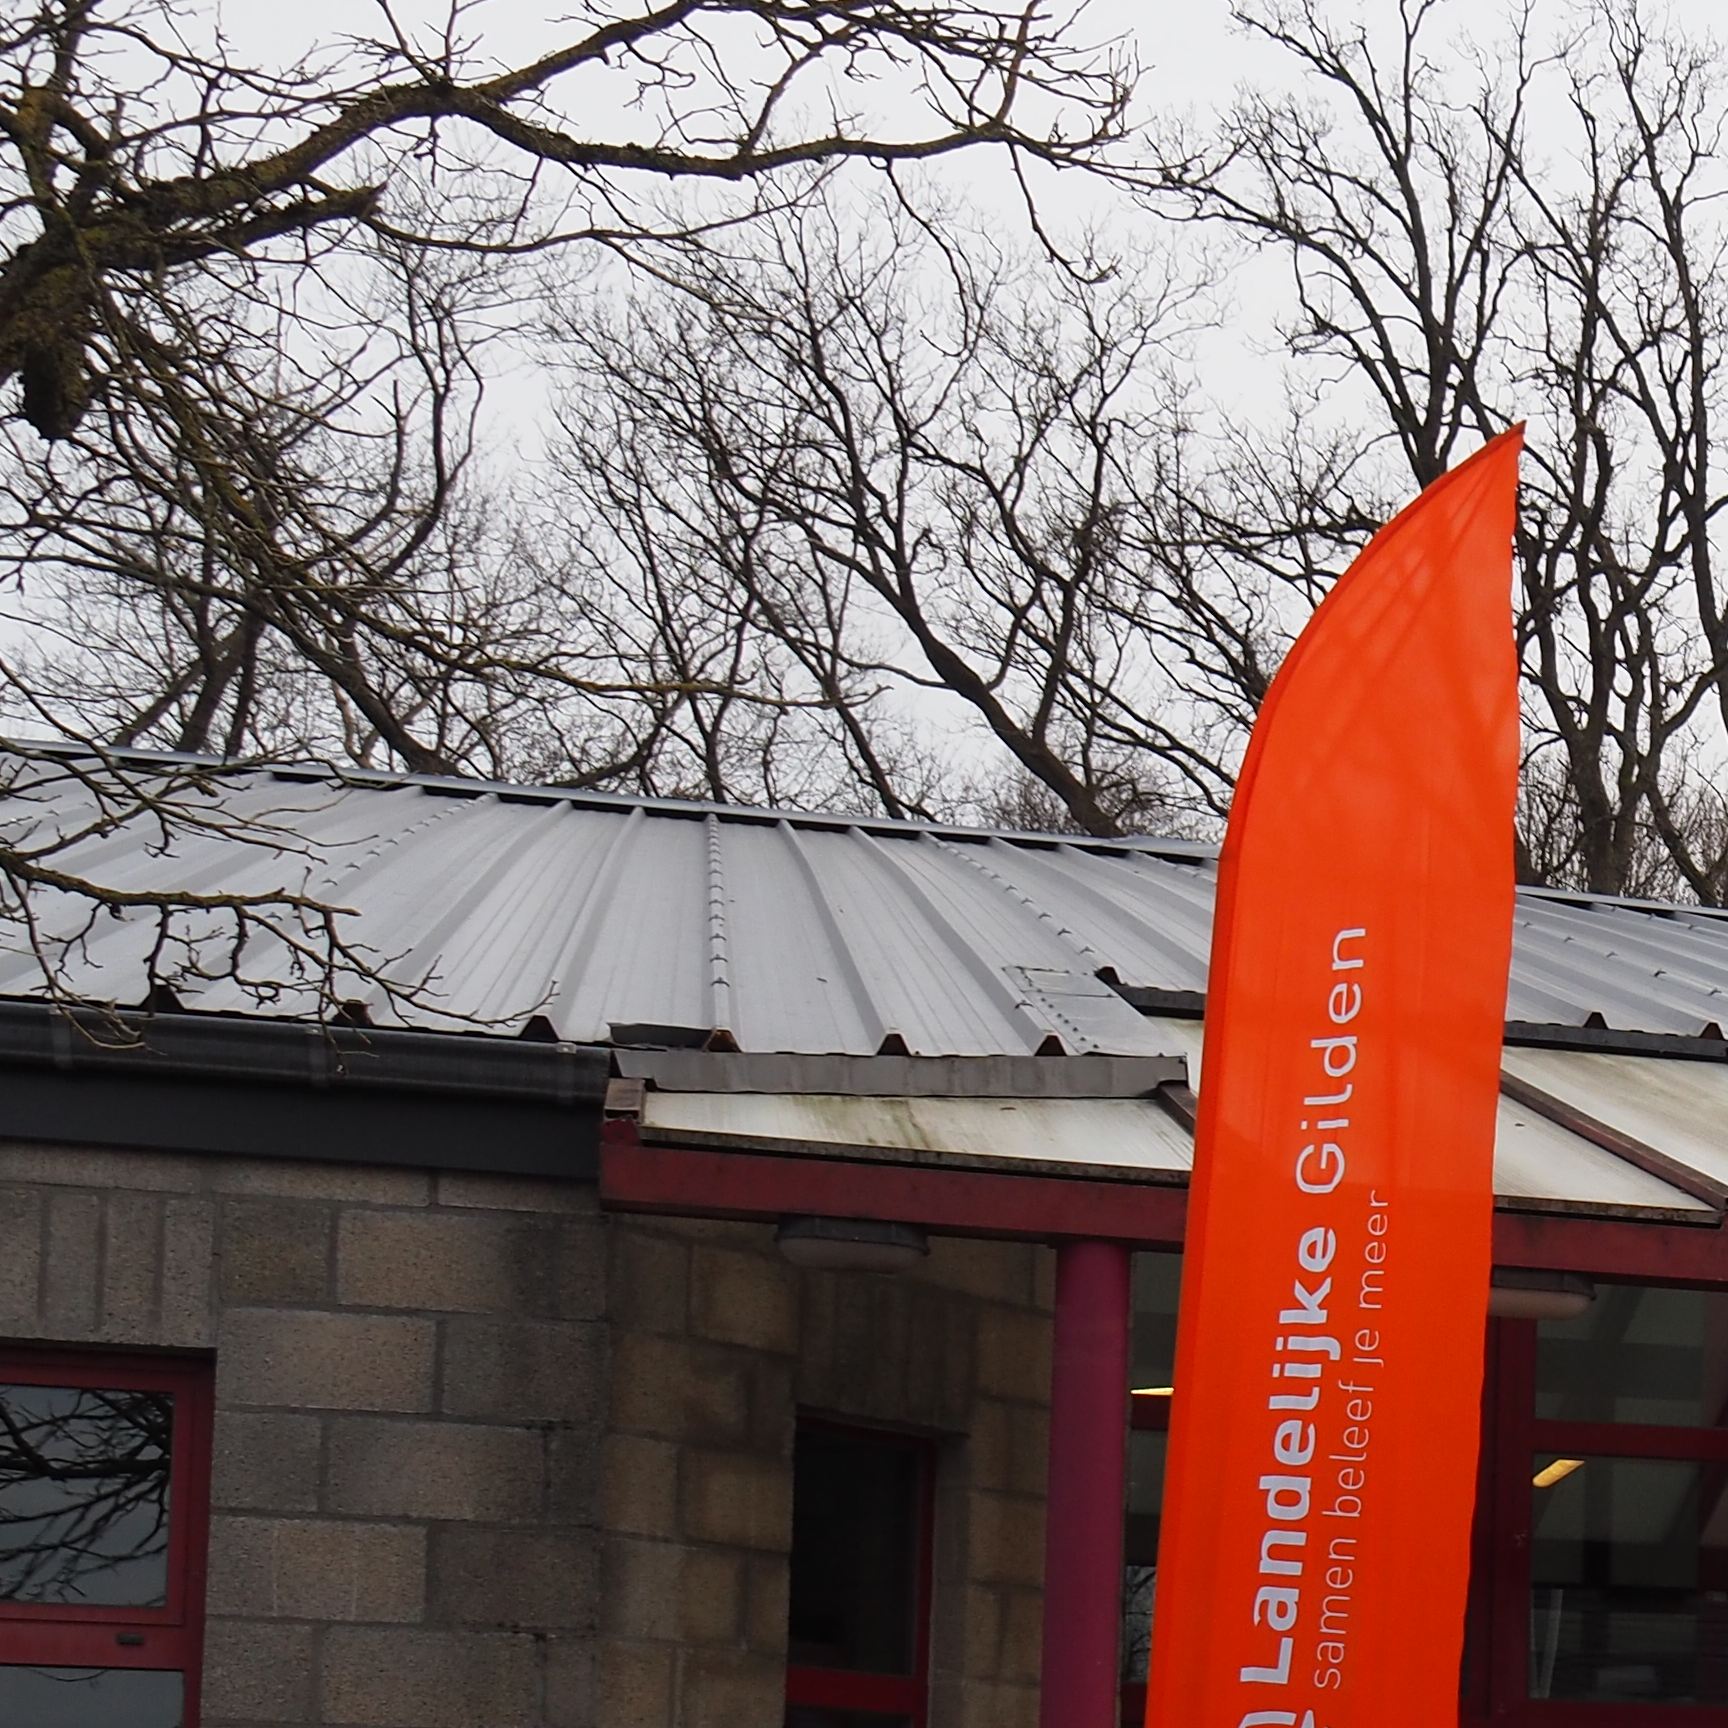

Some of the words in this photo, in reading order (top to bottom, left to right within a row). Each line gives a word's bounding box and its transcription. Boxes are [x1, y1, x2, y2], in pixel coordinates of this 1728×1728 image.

[1240, 1227, 1341, 1684] Landelijke
[1296, 928, 1366, 1193] Gilden
[1360, 1191, 1388, 1308] meer
[1348, 1330, 1384, 1364] je
[1323, 1381, 1373, 1516] beleef
[1315, 1539, 1356, 1689] samen
